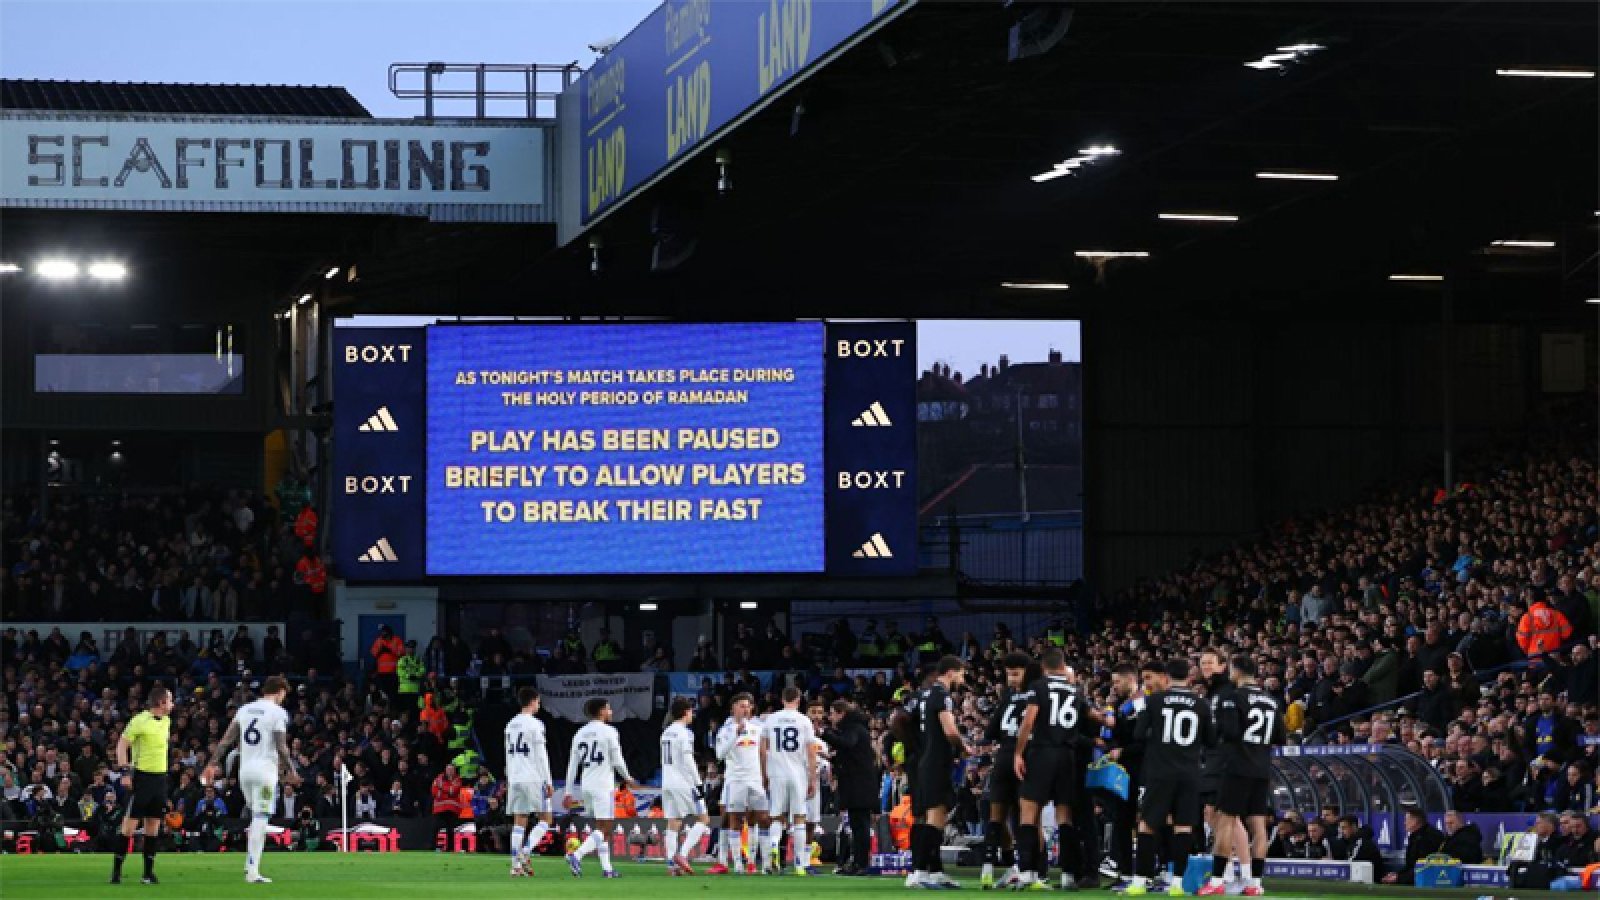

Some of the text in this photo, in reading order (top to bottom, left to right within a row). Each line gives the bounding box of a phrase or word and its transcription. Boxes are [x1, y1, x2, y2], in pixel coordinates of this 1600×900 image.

[758, 0, 811, 94] LAND
[667, 60, 711, 161] LAND
[27, 135, 490, 191] SCAFFOLDING
[588, 125, 625, 215] LAND
[346, 346, 410, 362] BOXT
[838, 340, 904, 356] BOXT
[456, 368, 794, 384] AS TONIGHT'S MATCH TAKES PLACE DURING
[502, 390, 747, 405] THE HOLY PERIOD OF RAMADAN
[472, 428, 780, 451] PLAY HAS BEEN PAUSED
[346, 476, 410, 492] BOXT
[446, 462, 806, 486] BRIEFLY TO ALLOW PLAYERS
[840, 472, 904, 488] BOXT
[482, 498, 762, 522] TO BREAK THEIR FAST
[1049, 691, 1078, 729] 16
[243, 717, 262, 747] 6
[773, 726, 799, 753] 18
[1161, 707, 1199, 746] 10
[1243, 707, 1275, 745] 21
[578, 740, 604, 768] 24
